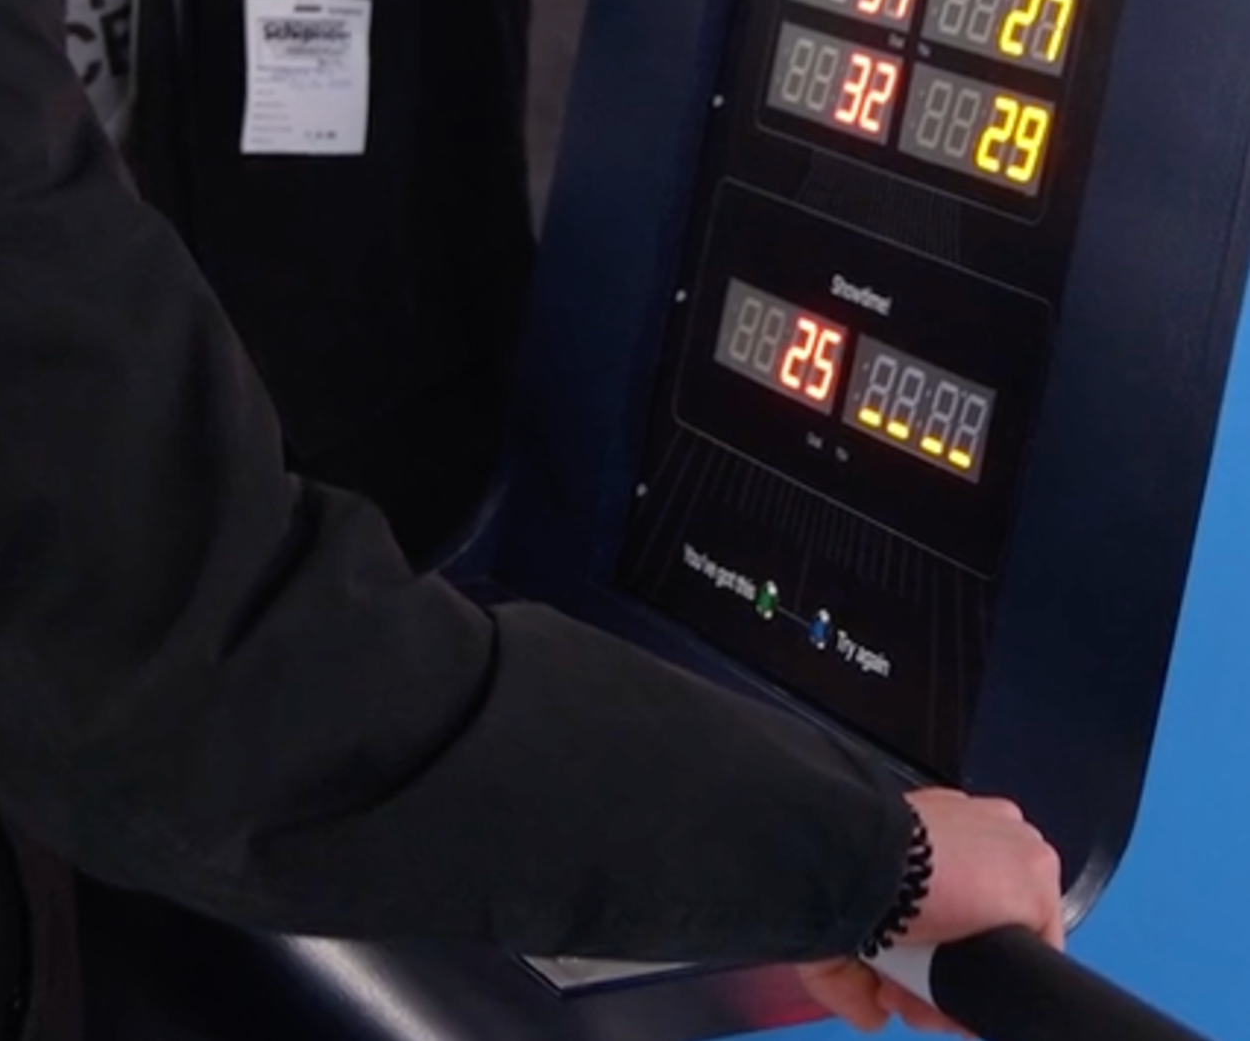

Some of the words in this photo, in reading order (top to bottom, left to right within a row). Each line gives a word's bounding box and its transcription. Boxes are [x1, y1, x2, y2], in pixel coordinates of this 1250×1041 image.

[834, 53, 898, 133] 32
[976, 96, 1050, 183] 29
[780, 316, 842, 401] 25
[836, 629, 858, 661] Try
[855, 645, 891, 678] again
